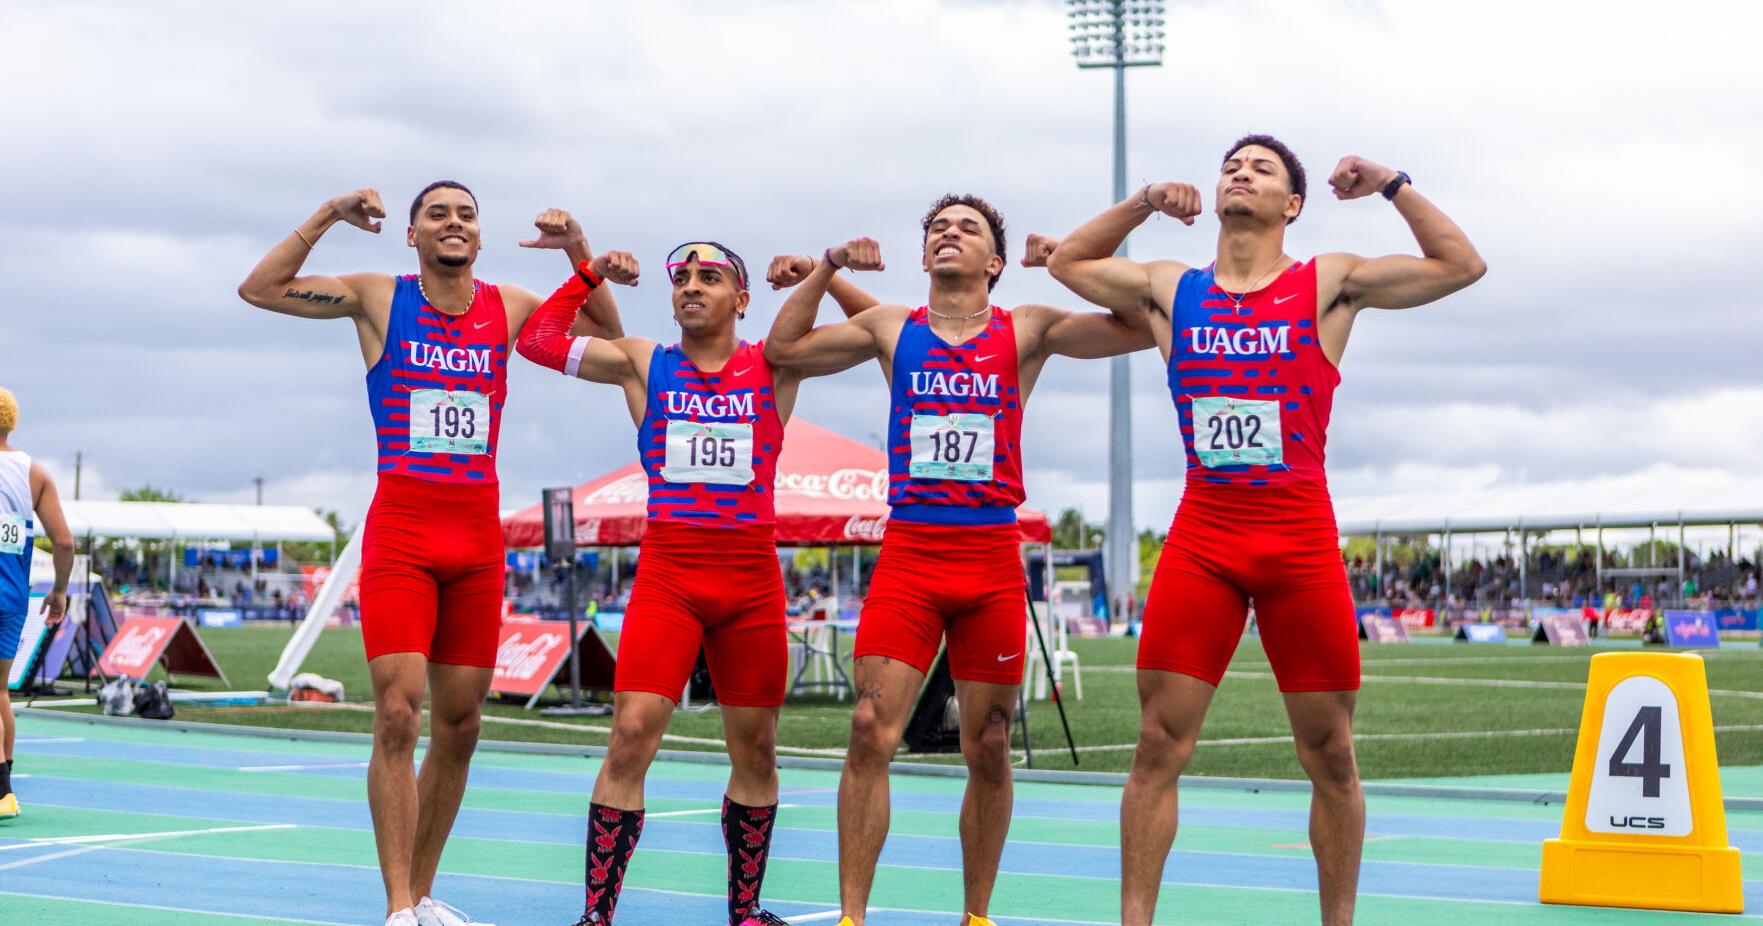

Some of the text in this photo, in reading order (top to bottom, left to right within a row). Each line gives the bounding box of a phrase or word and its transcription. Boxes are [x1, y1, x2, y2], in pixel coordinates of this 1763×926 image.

[1190, 326, 1291, 355] UAGM
[409, 341, 492, 373] UAGM
[910, 371, 999, 398] UAGM
[666, 391, 755, 417] UAGM
[430, 406, 475, 438] 193
[1208, 415, 1263, 450] 202
[686, 436, 735, 467] 195
[930, 430, 978, 463] 187
[2, 523, 18, 544] 39
[1609, 706, 1670, 797] 4
[1610, 816, 1665, 829] UCS
